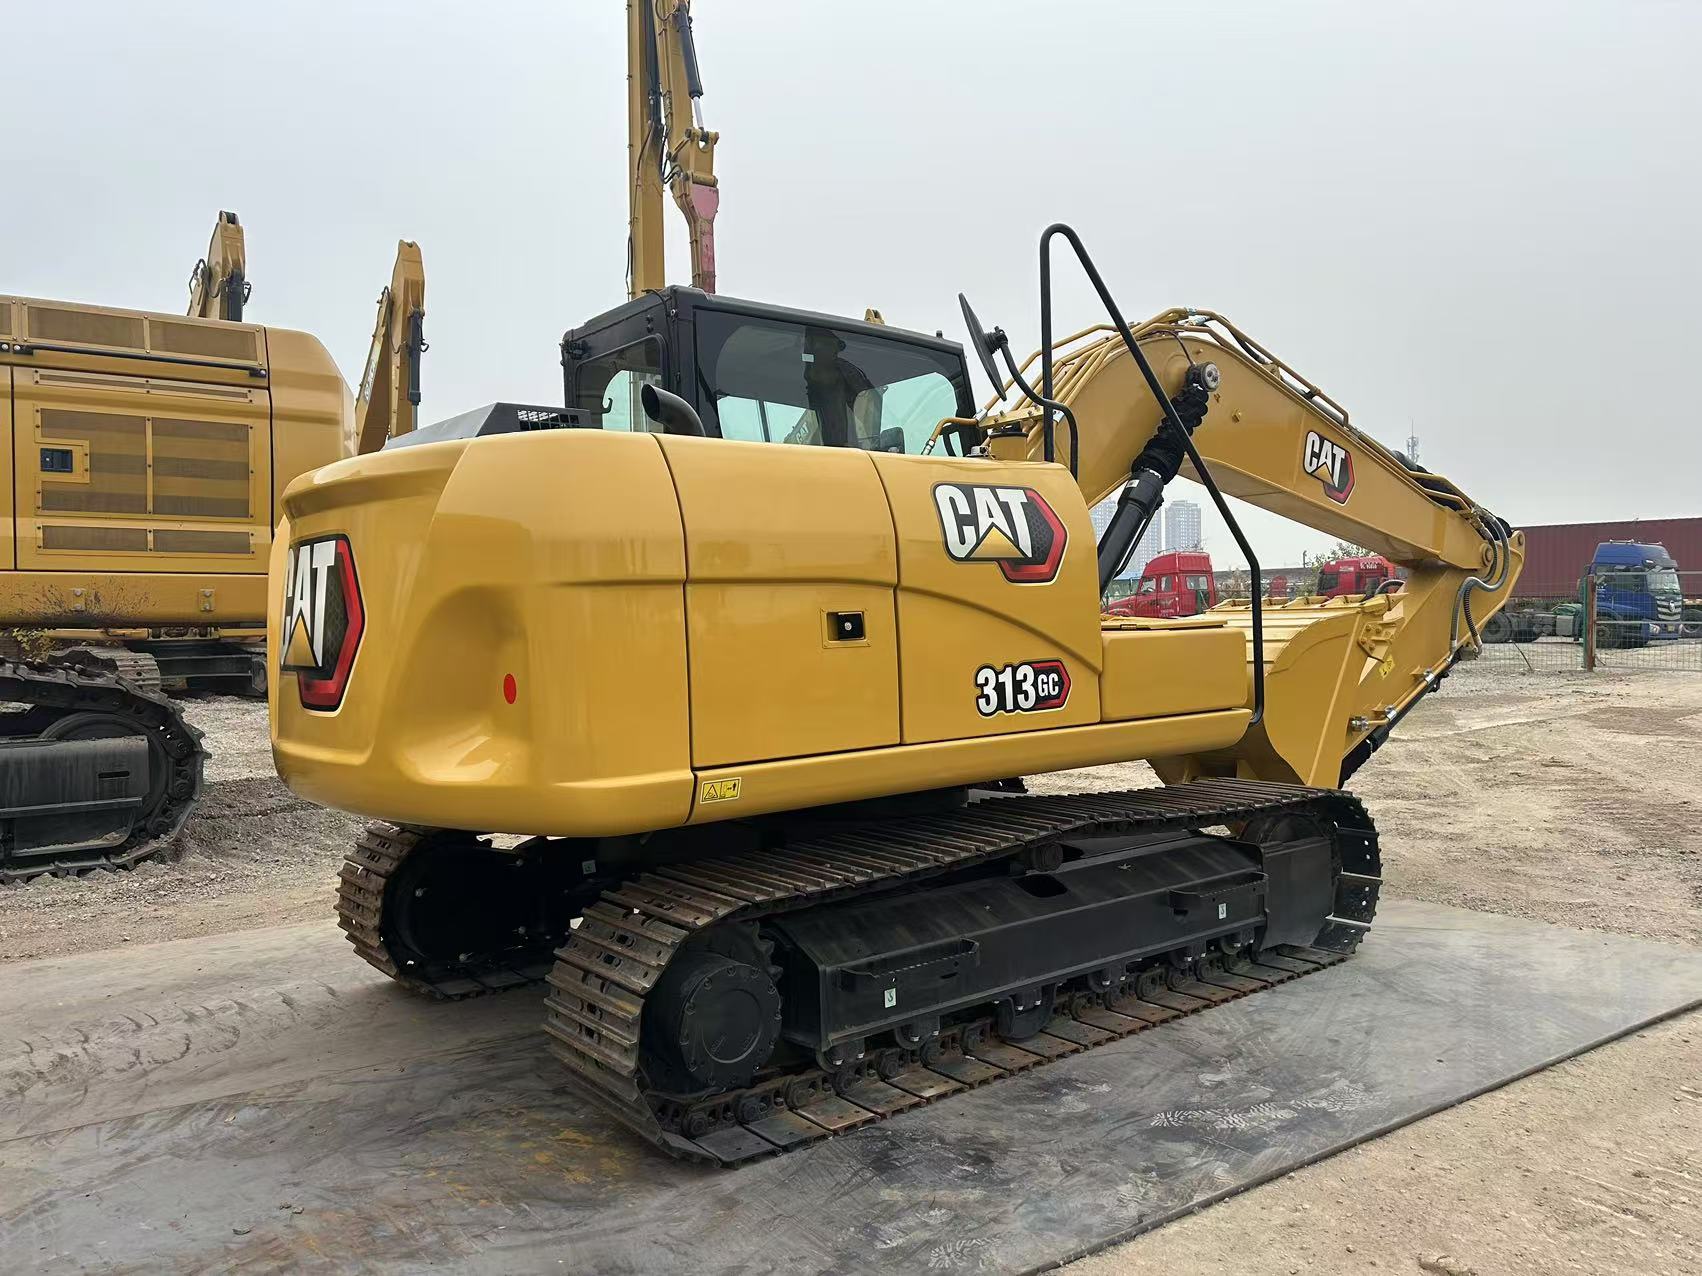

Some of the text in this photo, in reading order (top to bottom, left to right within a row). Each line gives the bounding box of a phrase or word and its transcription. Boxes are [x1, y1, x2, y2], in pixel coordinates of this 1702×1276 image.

[1304, 431, 1346, 487] CAT
[935, 484, 1032, 558] CAT
[281, 540, 336, 667] CAT
[976, 664, 1059, 713] 313 GC
